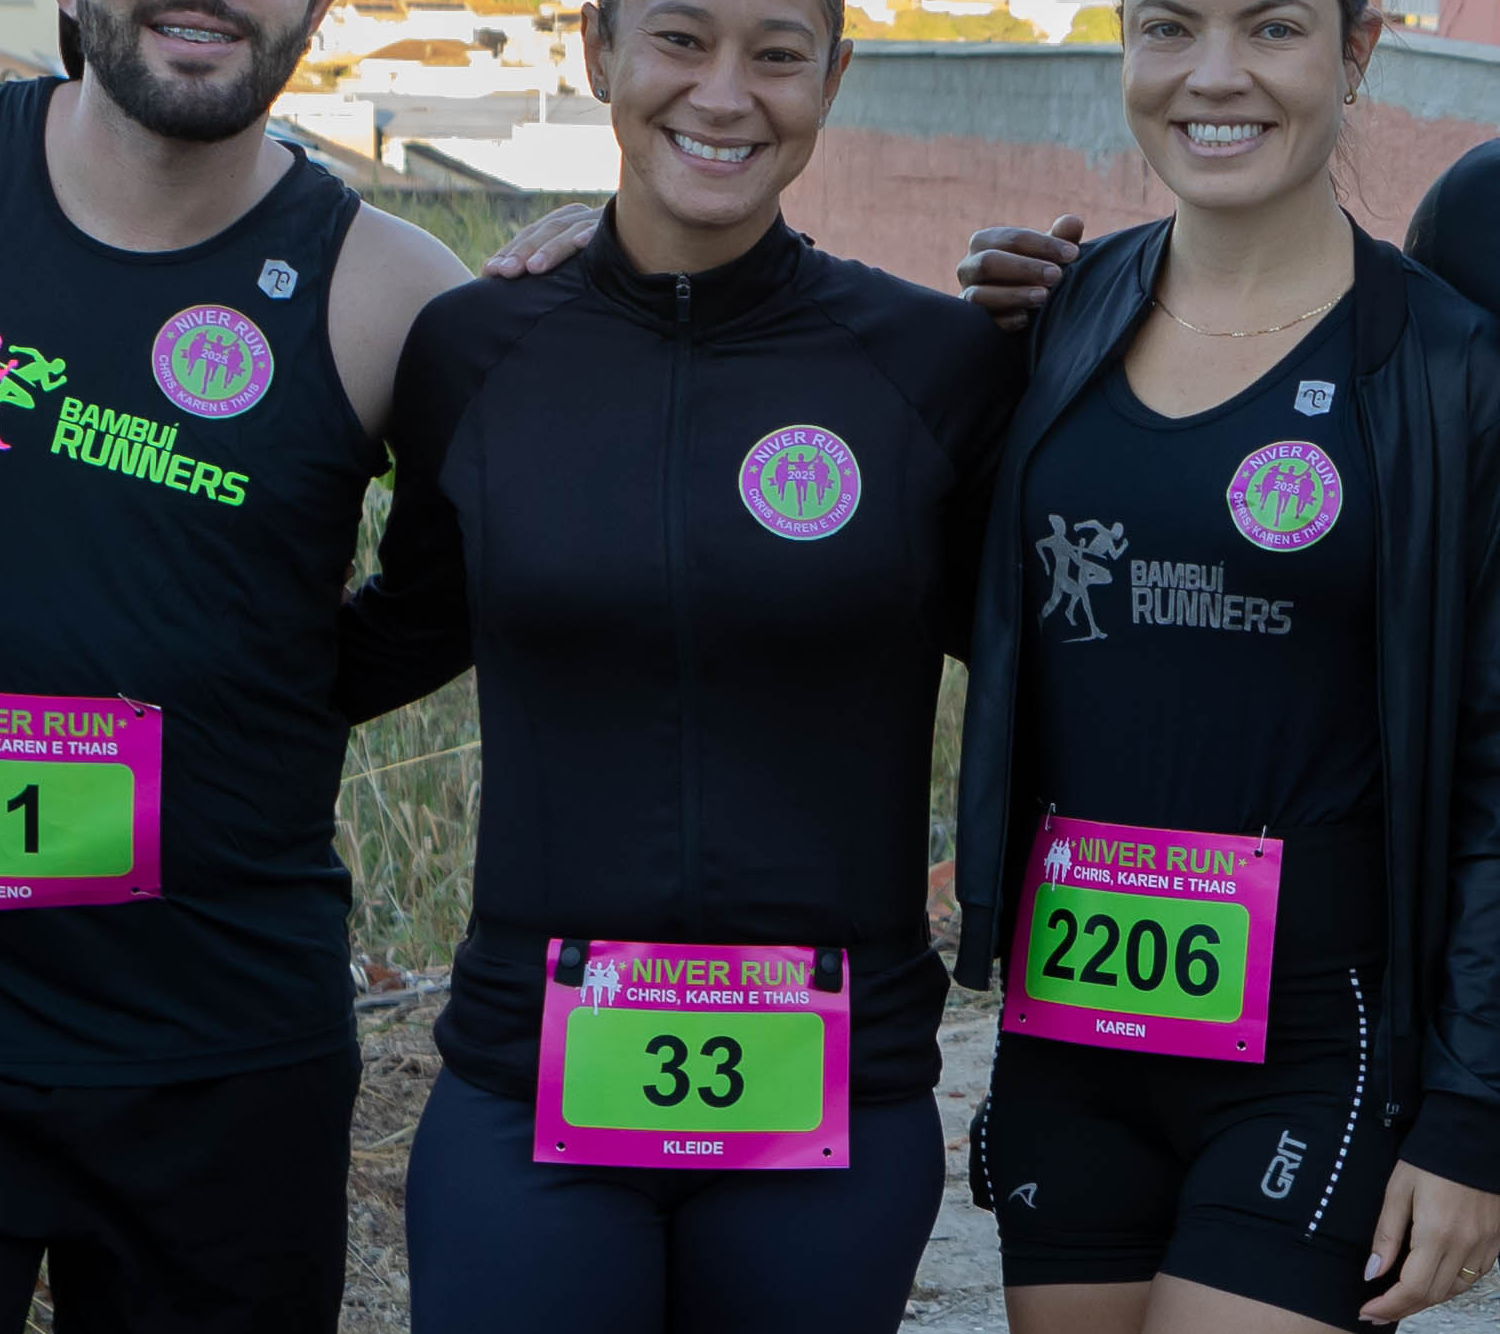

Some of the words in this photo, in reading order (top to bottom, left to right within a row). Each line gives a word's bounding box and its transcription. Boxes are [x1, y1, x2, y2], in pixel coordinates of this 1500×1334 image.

[174, 311, 231, 334] NIVER
[234, 321, 265, 357] RUN
[201, 349, 229, 364] 2025
[178, 391, 218, 412] KAREN
[221, 402, 228, 411] E
[231, 383, 260, 408] THAIS
[60, 397, 180, 451] BAMBUÍ
[51, 420, 249, 506] RUNNERS
[754, 431, 807, 463] NIVER
[812, 433, 848, 464] RUN
[788, 471, 816, 480] 2025
[1250, 446, 1302, 470] NIVER
[1305, 451, 1336, 486] RUN
[1274, 480, 1300, 495] 2025
[776, 517, 818, 533] KAREN
[820, 518, 828, 528] E
[828, 493, 852, 523] THAIS
[1251, 526, 1291, 545] KAREN
[1293, 533, 1301, 543] E
[1301, 512, 1330, 538] THAIS
[1130, 560, 1225, 592] BAMBUÍ
[1132, 587, 1294, 634] RUNNERS
[43, 712, 114, 737] RUN
[52, 741, 63, 754] E
[68, 741, 118, 756] THAIS
[1078, 837, 1156, 869] NIVER
[1167, 846, 1234, 875] RUN
[1074, 866, 1114, 885] CHRIS,
[1117, 872, 1169, 888] KAREN
[1174, 877, 1183, 890] E
[1188, 878, 1237, 894] THAIS
[1042, 908, 1221, 996] 2206
[631, 959, 730, 985] NIVER
[741, 962, 805, 985] RUN
[626, 988, 681, 1005] CHRIS,
[687, 991, 743, 1004] KAREN
[749, 991, 759, 1004] E
[764, 991, 809, 1004] THAIS
[1096, 1019, 1145, 1037] KAREN
[643, 1035, 745, 1108] 33
[663, 1141, 724, 1154] KLEIDE
[1261, 1130, 1307, 1199] GRIT
